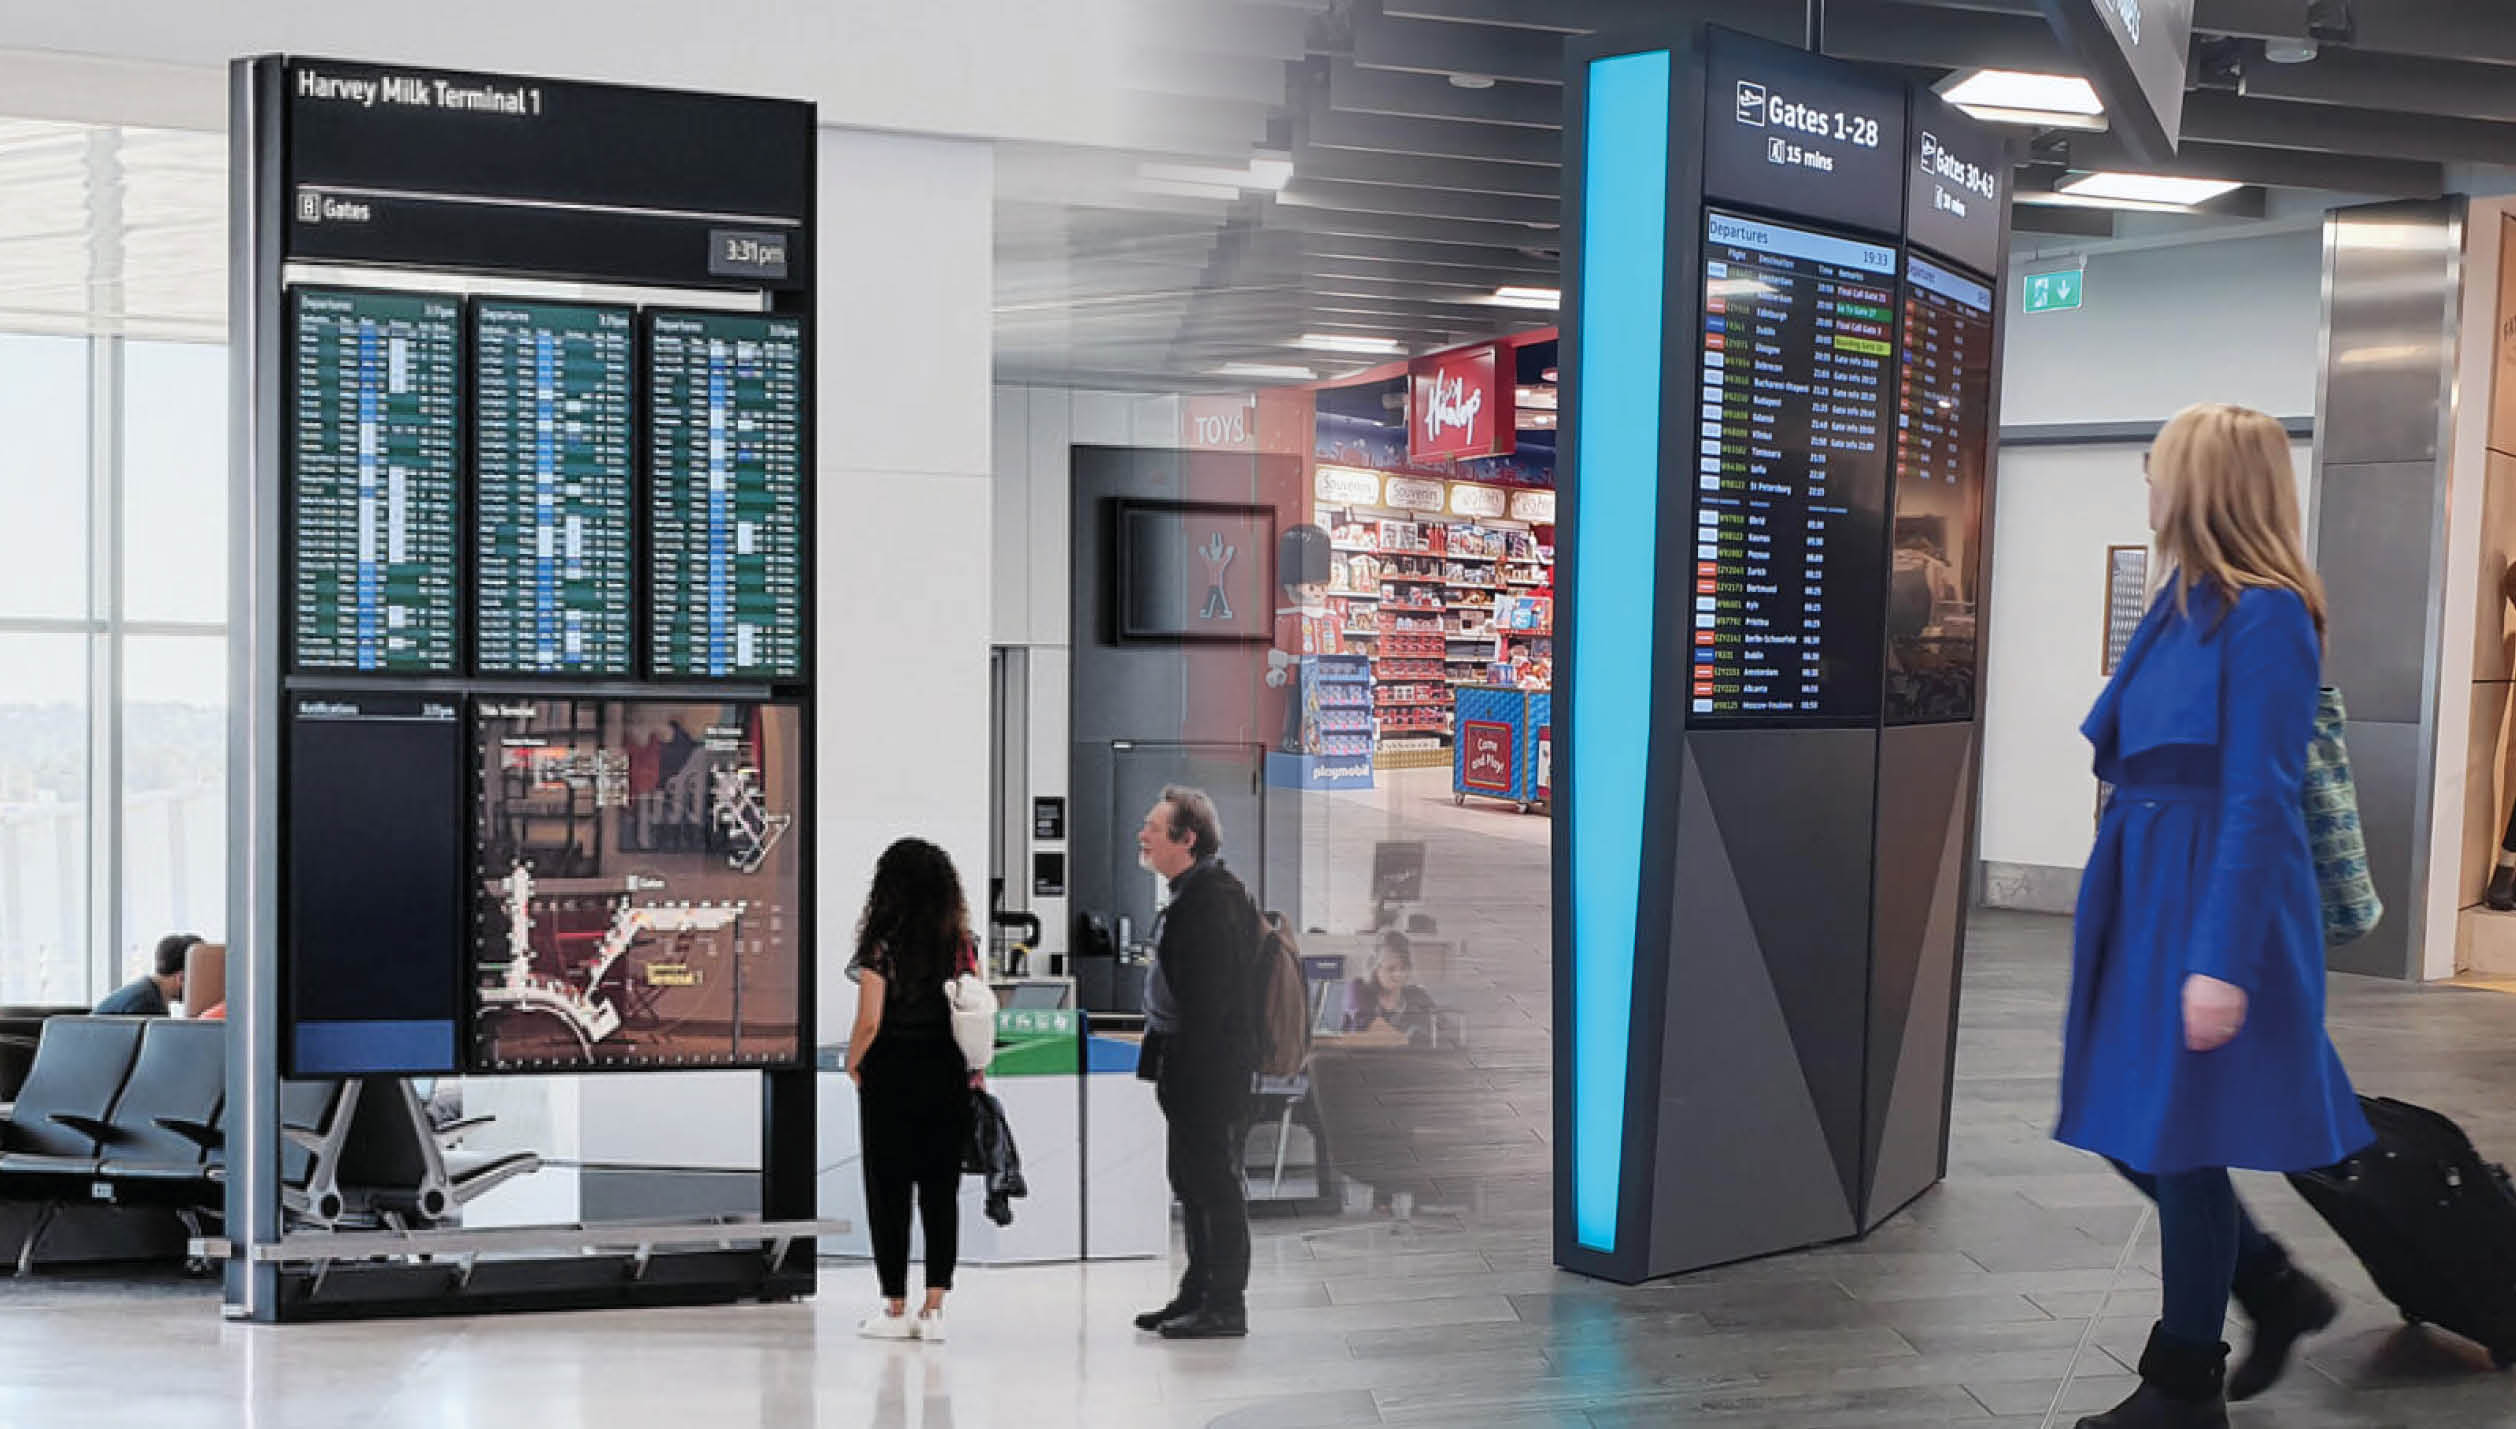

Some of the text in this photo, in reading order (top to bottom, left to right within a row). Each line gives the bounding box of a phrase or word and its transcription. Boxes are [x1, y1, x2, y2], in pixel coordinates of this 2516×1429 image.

[298, 70, 540, 116] Harvey Milk Terminal 1
[1768, 95, 1879, 149] Gates 1-28
[1786, 144, 1833, 172] 15 mins
[1936, 147, 1994, 199] Gates 30-43
[324, 197, 371, 221] Gates
[1709, 220, 1769, 246] Departures
[1862, 251, 1889, 267] 19:33
[1195, 415, 1245, 444] TOYS
[1477, 738, 1498, 752] Come
[1313, 763, 1370, 780] playmobil
[1471, 754, 1485, 770] and
